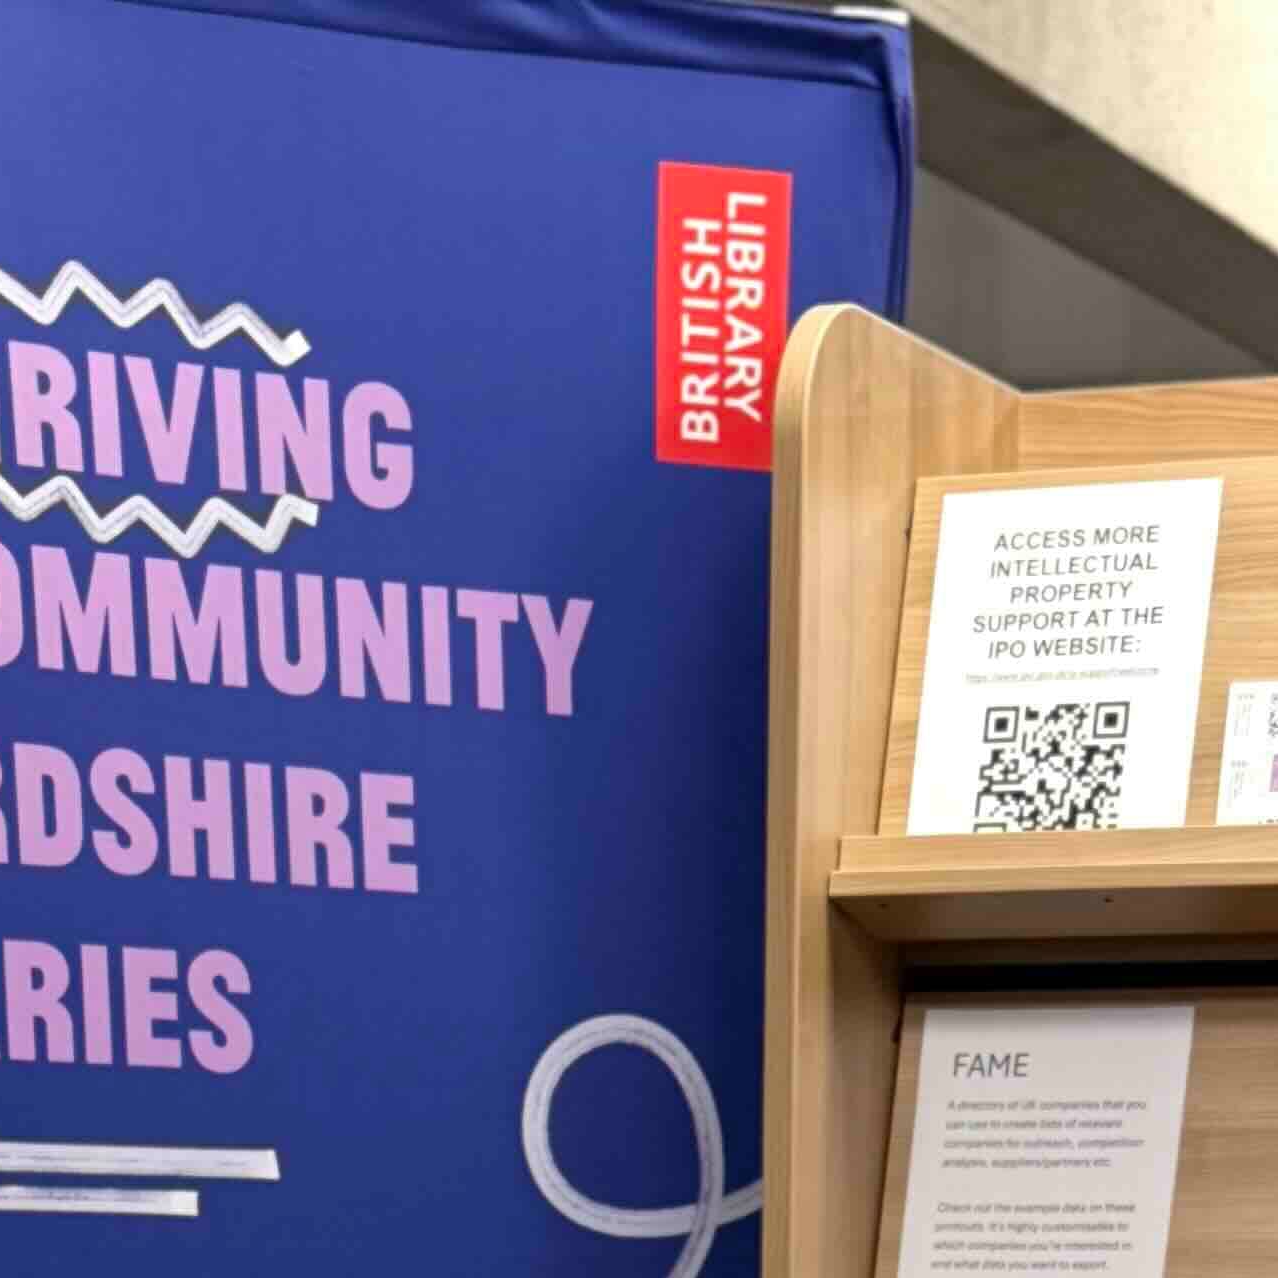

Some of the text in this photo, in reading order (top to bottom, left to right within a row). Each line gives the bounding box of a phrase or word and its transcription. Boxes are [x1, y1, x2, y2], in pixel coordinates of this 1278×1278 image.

[725, 192, 766, 420] LIBRARY
[682, 219, 722, 441] BRITISH
[994, 526, 1159, 552] ACCESS MORE
[991, 552, 1158, 577] INTELLECTUAL
[1010, 581, 1132, 603] PROPERTY
[974, 607, 1163, 632] SUPPORT AT THE
[988, 635, 1140, 658] IPO WEBSITE:
[954, 1053, 1029, 1077] FAME
